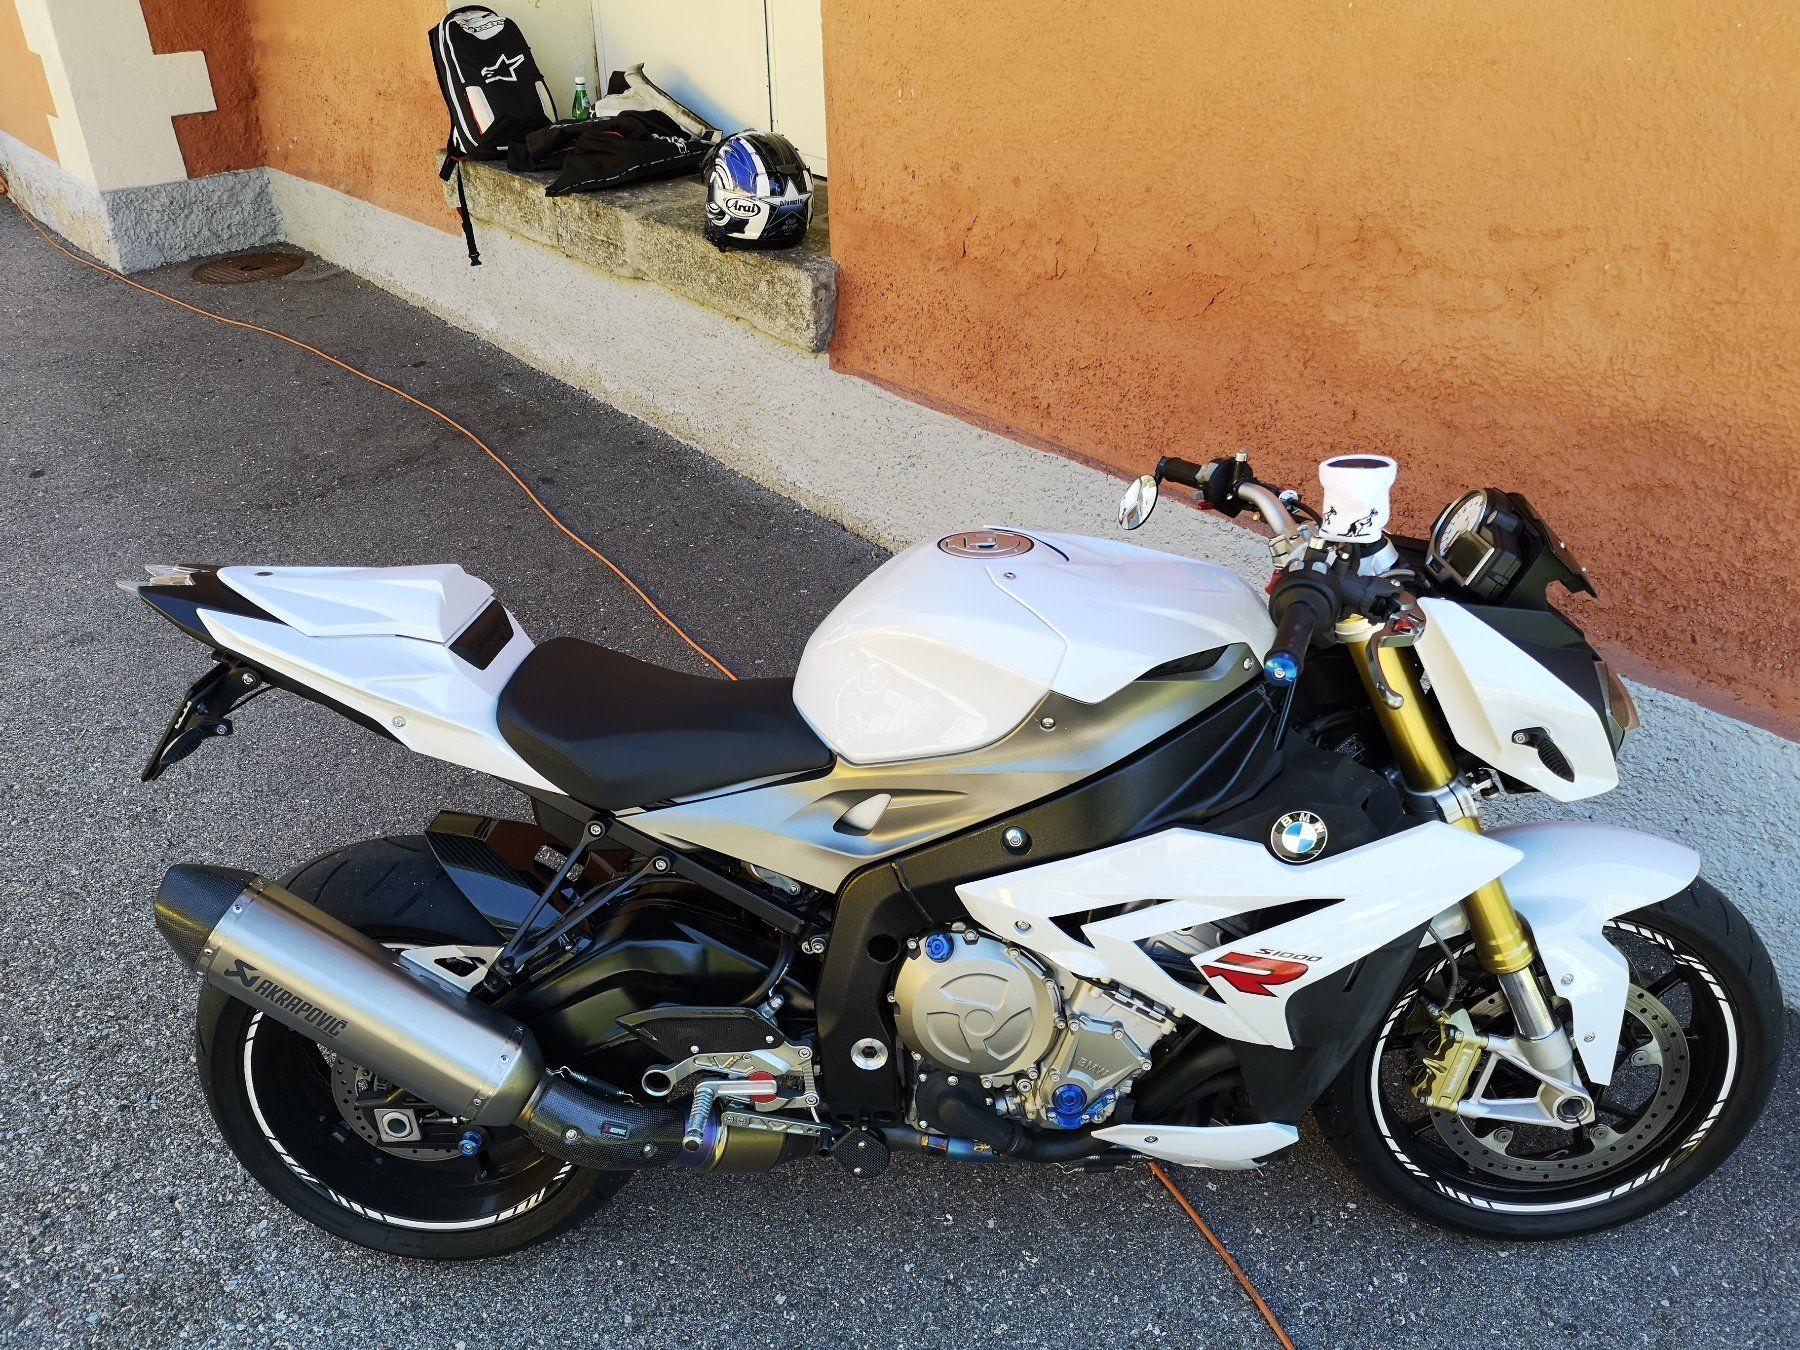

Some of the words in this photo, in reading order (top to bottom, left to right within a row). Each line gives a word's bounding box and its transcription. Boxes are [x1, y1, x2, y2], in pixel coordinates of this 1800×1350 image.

[727, 200, 757, 214] Arai
[1280, 812, 1325, 833] BMW
[1256, 948, 1323, 962] S1000
[1077, 1056, 1109, 1077] BMW
